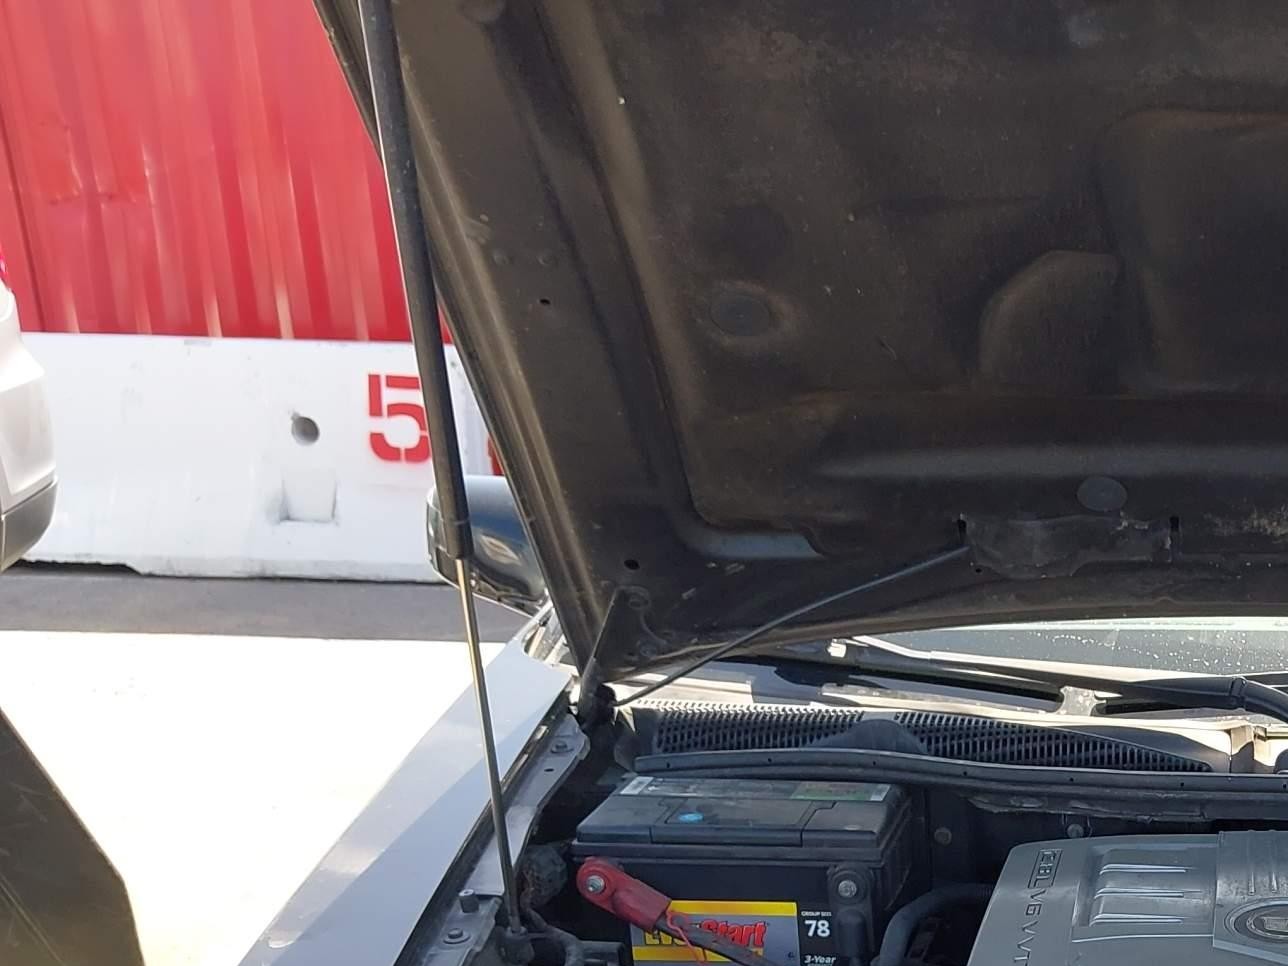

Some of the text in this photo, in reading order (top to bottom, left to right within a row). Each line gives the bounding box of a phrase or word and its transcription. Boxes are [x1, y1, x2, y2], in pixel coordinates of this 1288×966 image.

[368, 374, 432, 464] 5
[804, 920, 831, 937] 78
[804, 954, 837, 965] 3-Year
